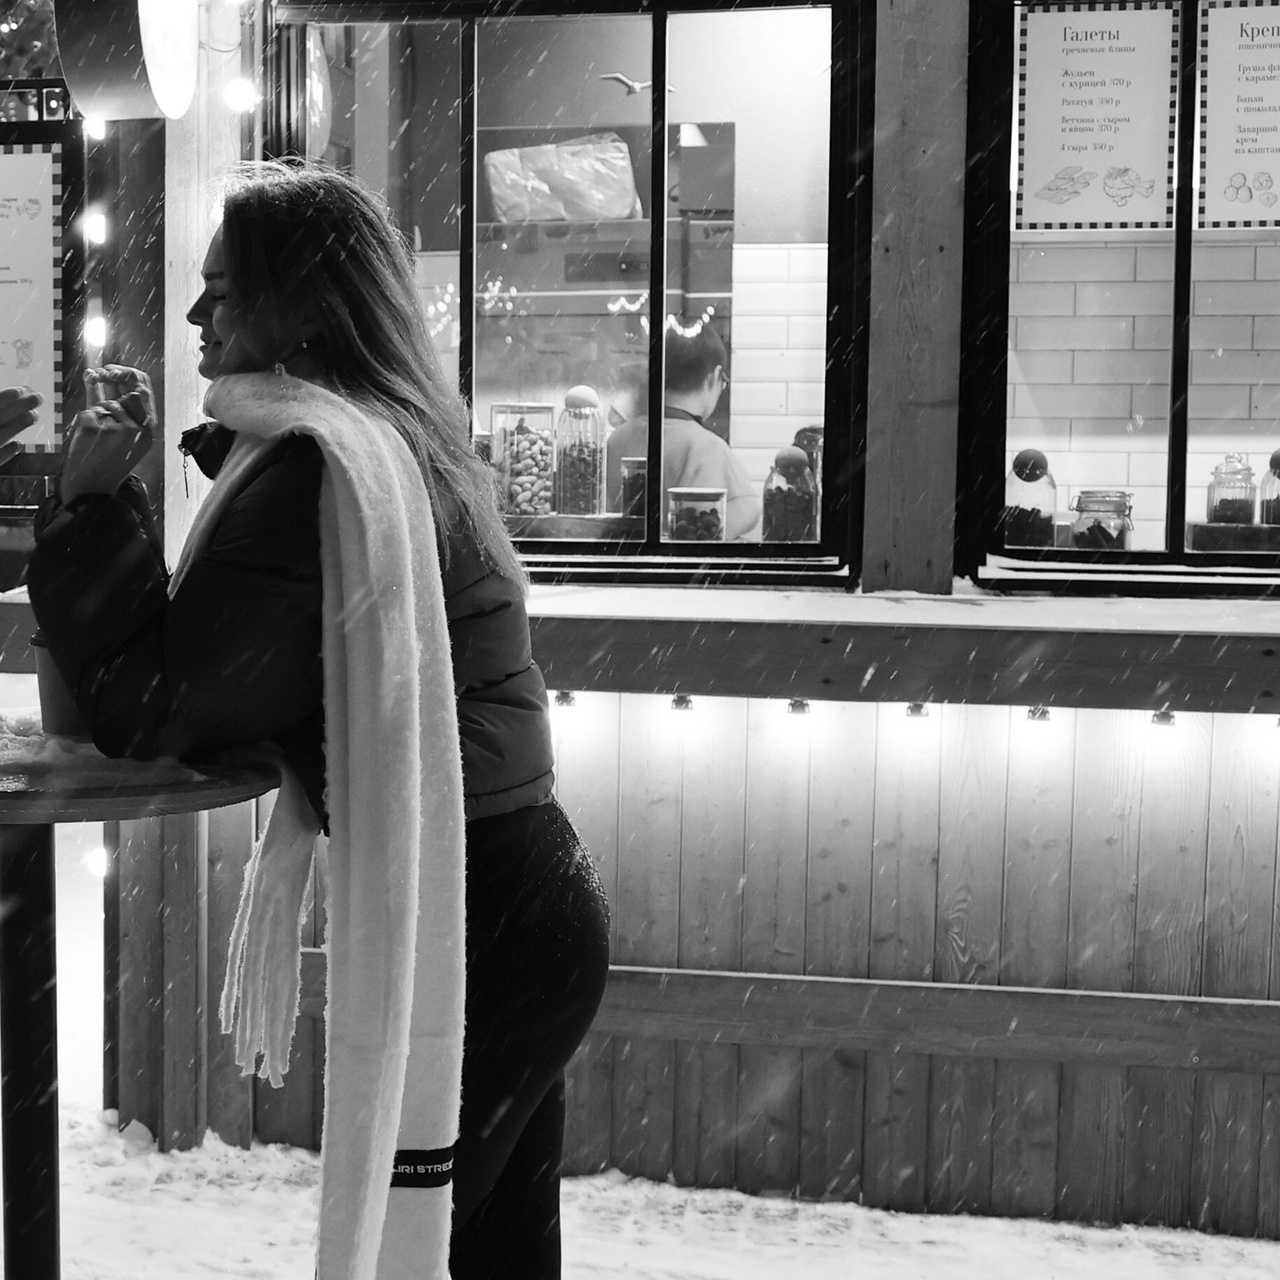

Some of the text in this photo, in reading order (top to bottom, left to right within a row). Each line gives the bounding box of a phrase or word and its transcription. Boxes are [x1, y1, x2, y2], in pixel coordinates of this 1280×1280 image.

[1063, 26, 1120, 41] Галеты
[1062, 68, 1095, 79] Жульен
[1238, 63, 1265, 74] Груша
[1069, 79, 1106, 89] курицей
[1061, 98, 1094, 108] Рататуй
[1236, 94, 1264, 103] Банан
[1103, 116, 1130, 125] сыром
[1236, 124, 1278, 136] Заварной
[1235, 137, 1258, 147] крем
[1067, 144, 1088, 153] сыра
